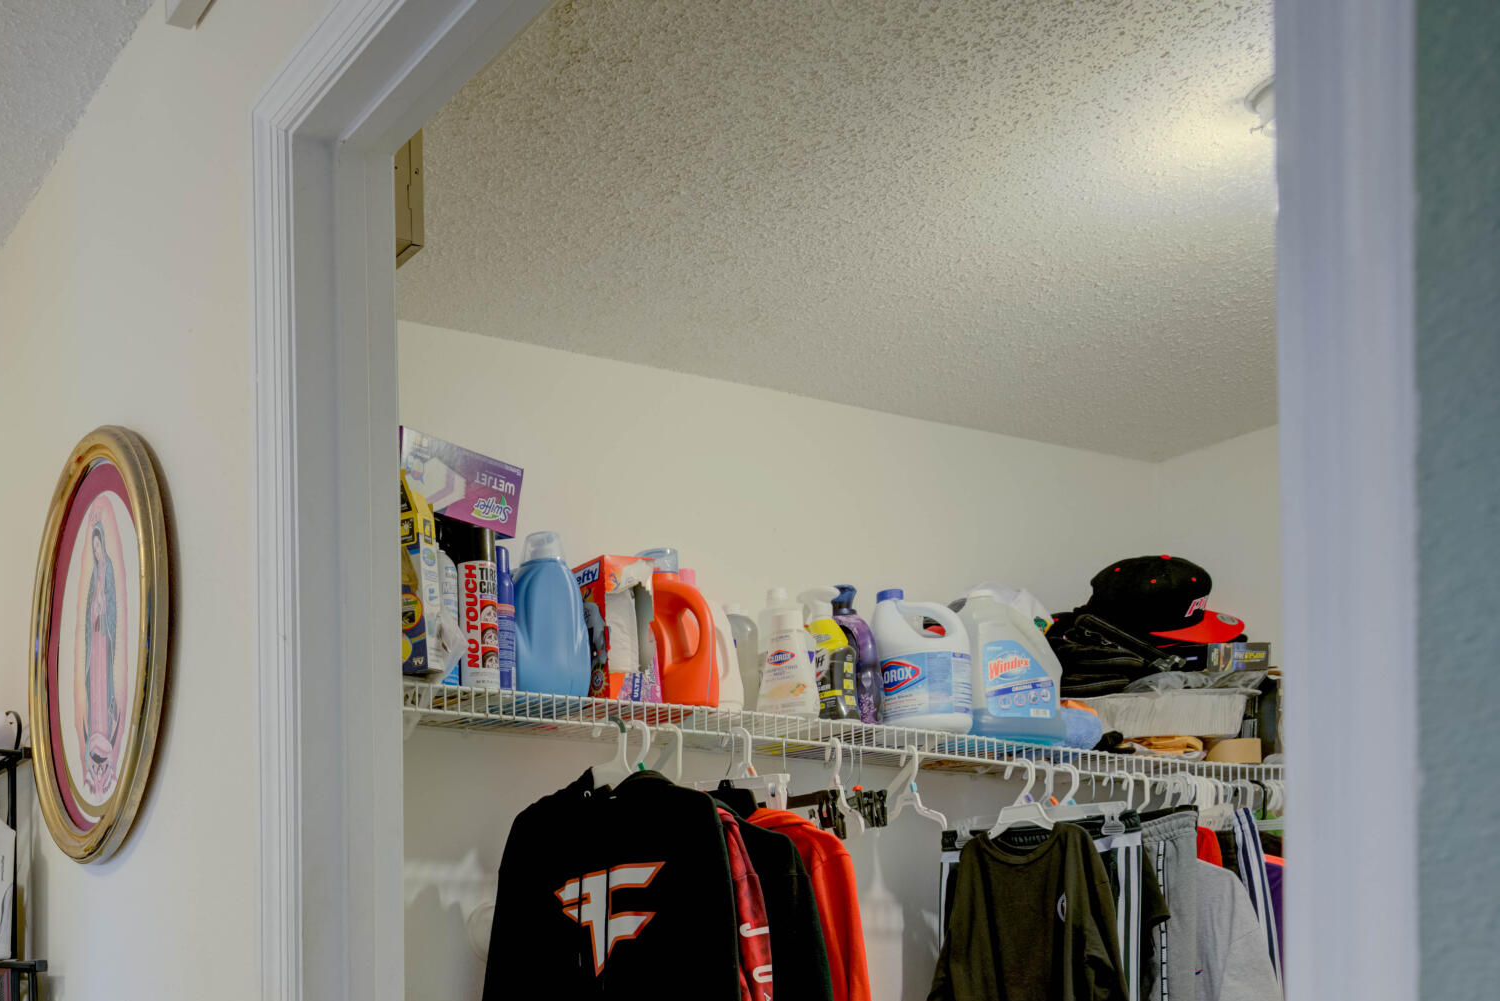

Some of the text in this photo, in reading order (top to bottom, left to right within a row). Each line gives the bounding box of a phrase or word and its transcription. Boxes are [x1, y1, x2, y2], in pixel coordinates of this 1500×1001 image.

[474, 472, 516, 496] WETJET
[474, 497, 512, 522] Swiffer
[576, 568, 598, 585] efty
[480, 581, 497, 595] CAR
[464, 564, 480, 668] NO TOUCH
[769, 653, 791, 663] CLOROX
[884, 667, 912, 684] OROX
[988, 657, 1030, 681] Windex
